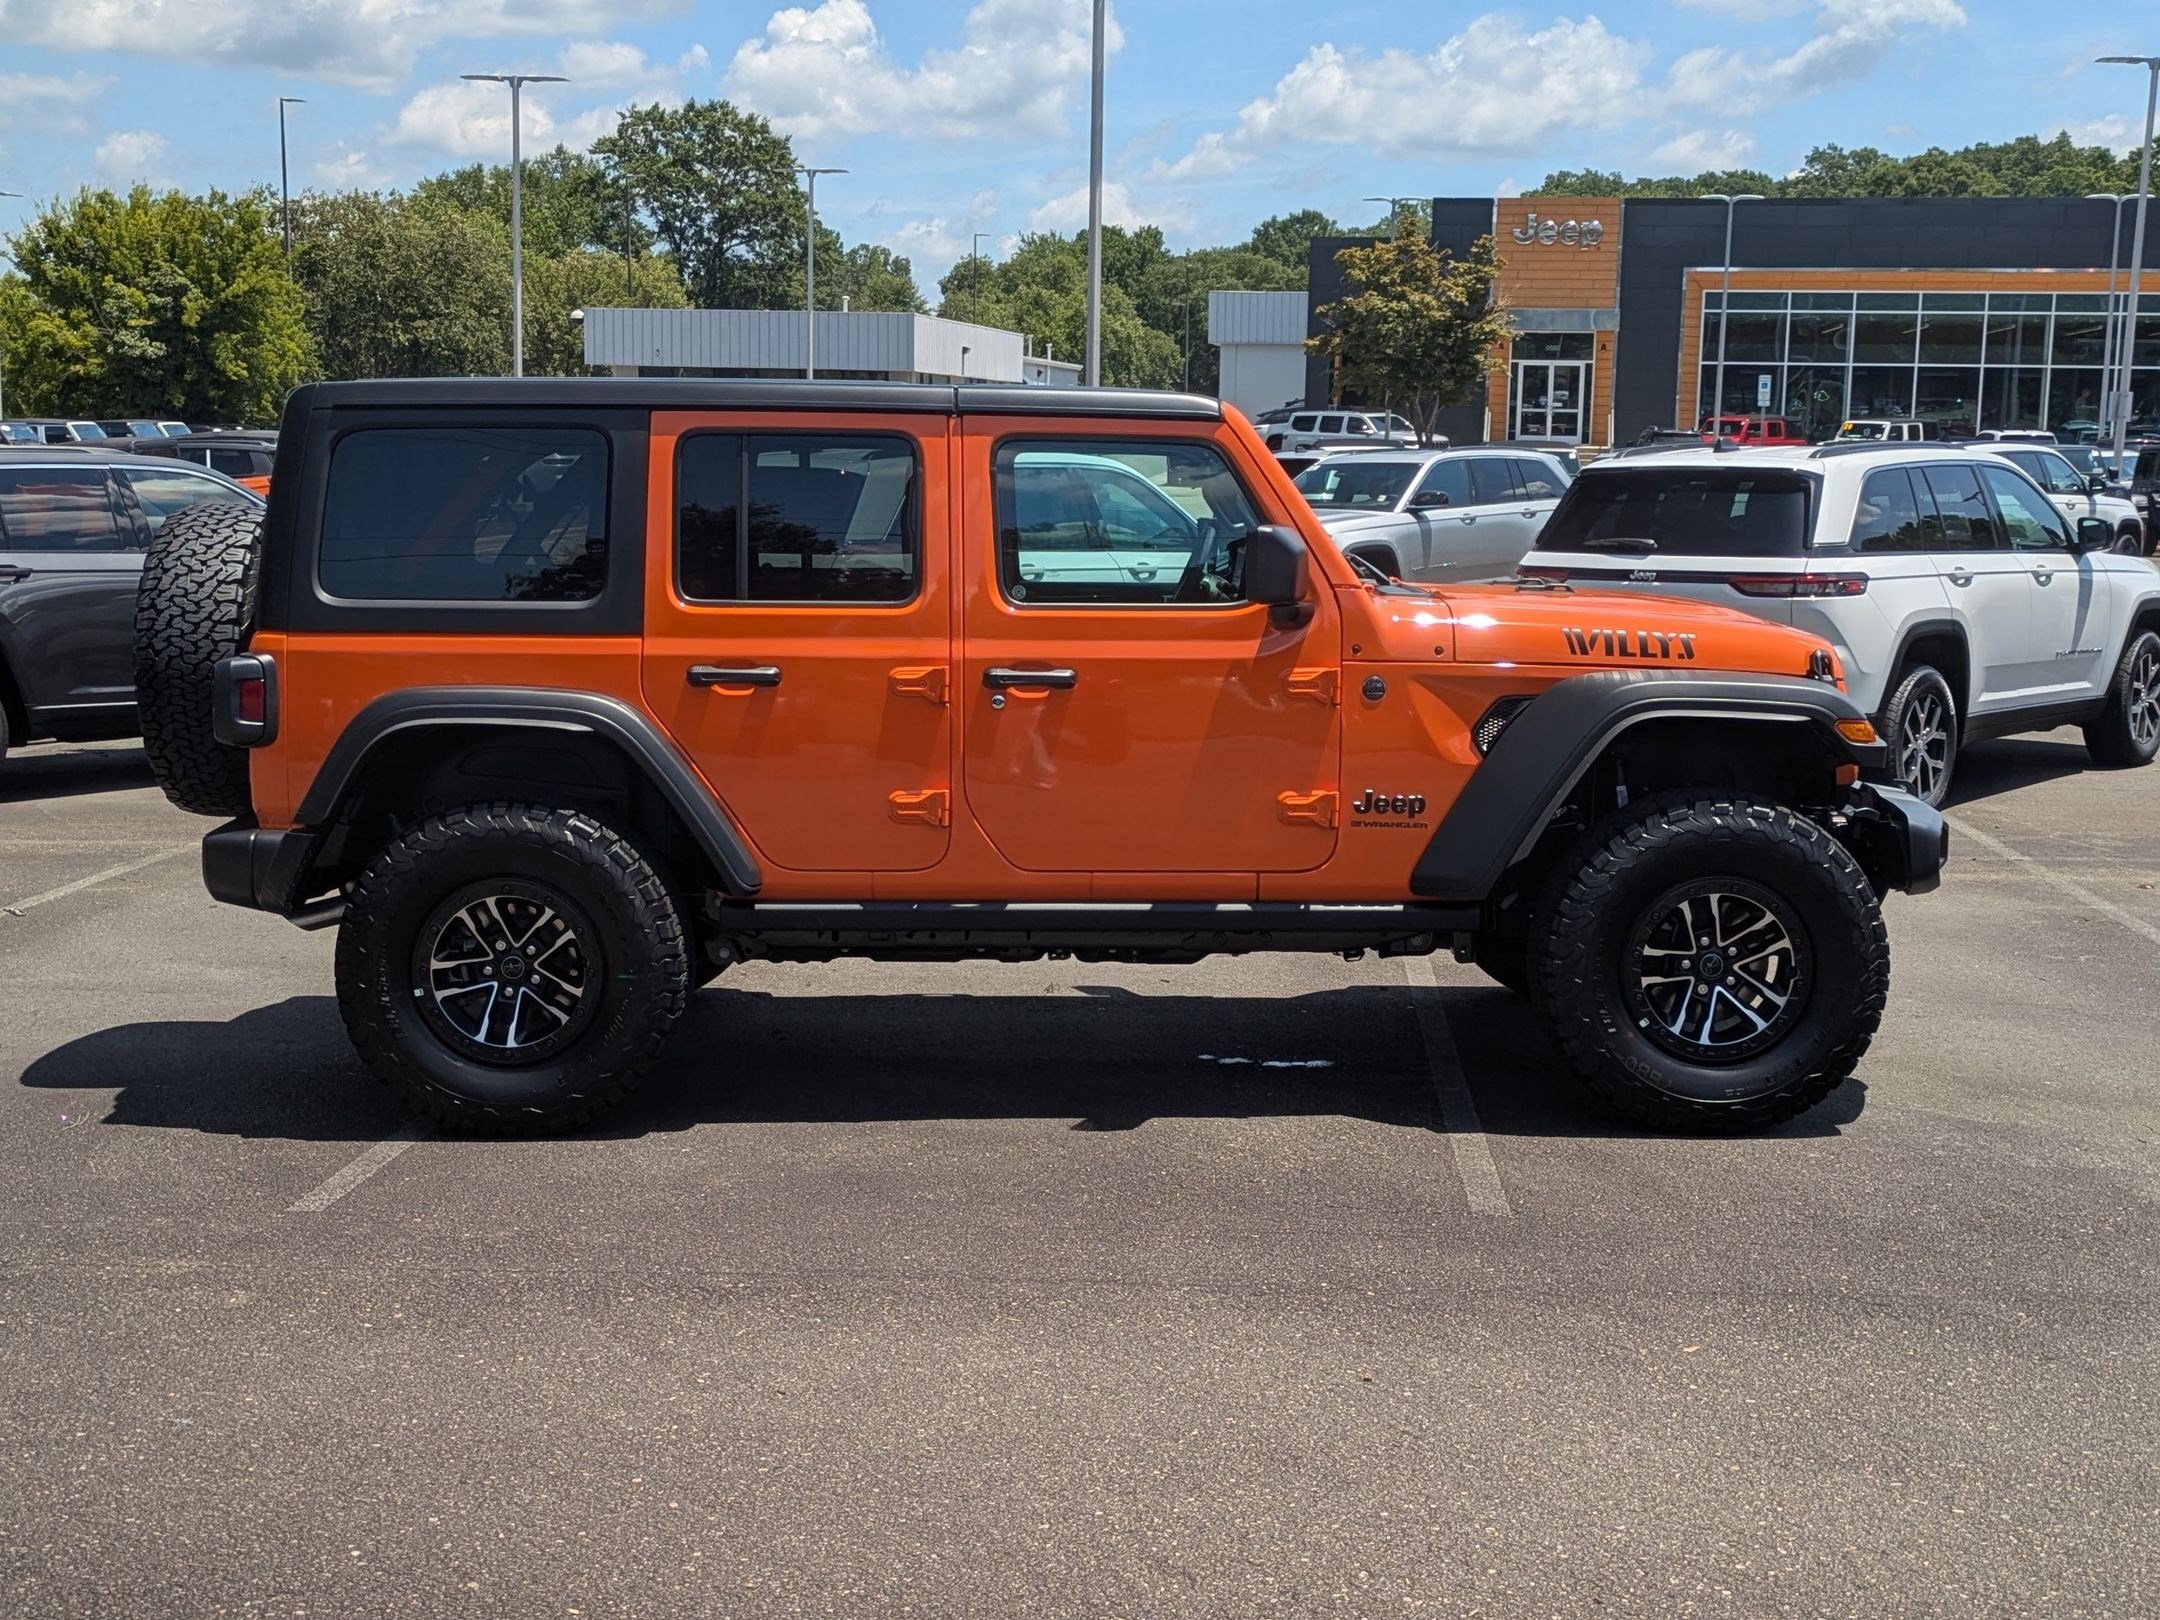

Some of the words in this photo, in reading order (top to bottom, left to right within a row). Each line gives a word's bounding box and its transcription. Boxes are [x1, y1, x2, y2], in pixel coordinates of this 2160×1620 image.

[1512, 213, 1603, 251] Jeep
[1629, 569, 1657, 581] Jeep
[1562, 627, 1697, 660] WILLYS
[1353, 789, 1426, 819] Jeep
[1361, 820, 1428, 829] WRANGLER
